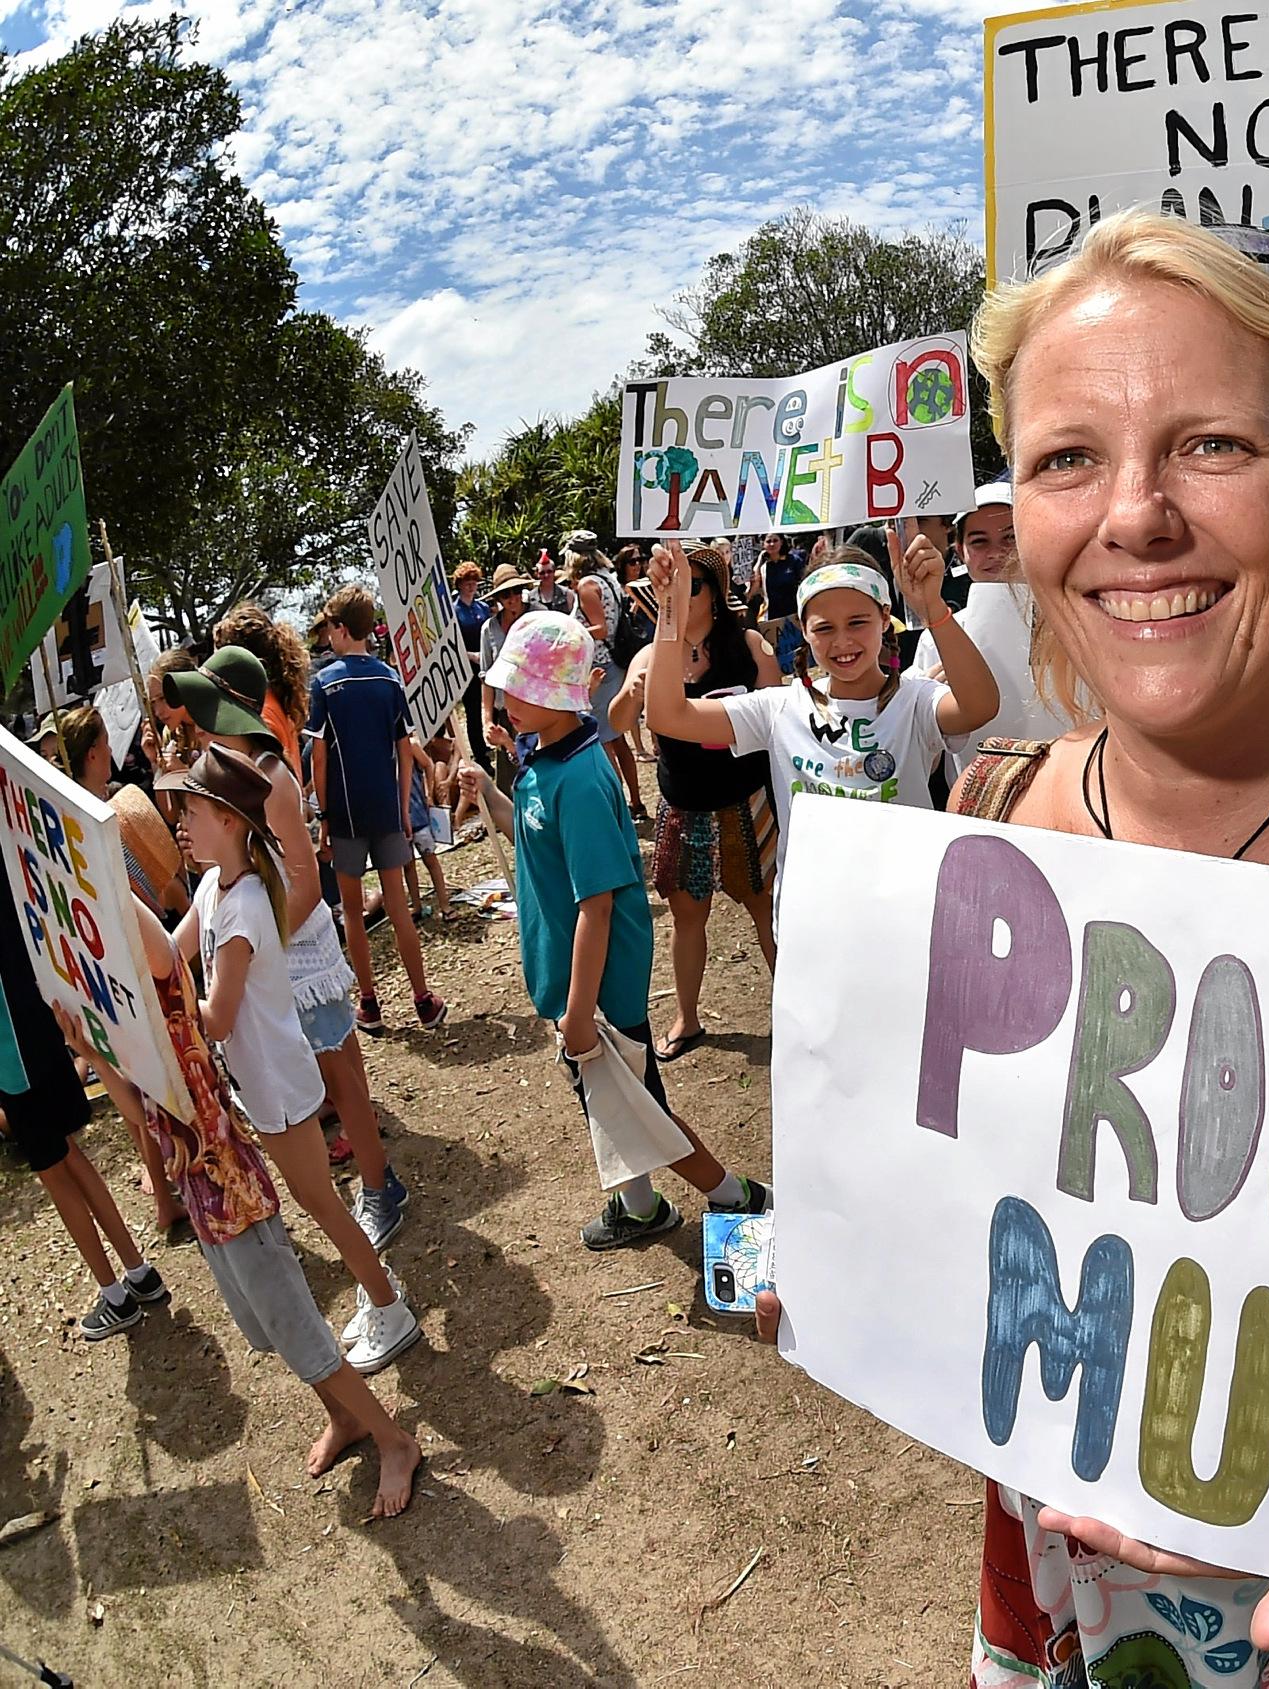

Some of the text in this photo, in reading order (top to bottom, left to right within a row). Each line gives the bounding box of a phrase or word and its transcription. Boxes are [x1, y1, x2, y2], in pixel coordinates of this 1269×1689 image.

[625, 381, 807, 448] There
[373, 441, 421, 570] SAVE
[866, 432, 904, 518] B
[394, 520, 426, 606] OUR
[394, 554, 453, 688] EARTH
[409, 623, 467, 739] TODAY
[792, 756, 864, 779] are the
[809, 712, 879, 752] WE
[0, 767, 97, 901] THERE
[17, 844, 49, 914] IS
[46, 870, 105, 961] NO
[24, 901, 137, 1025] PLANET
[82, 1004, 120, 1068] B
